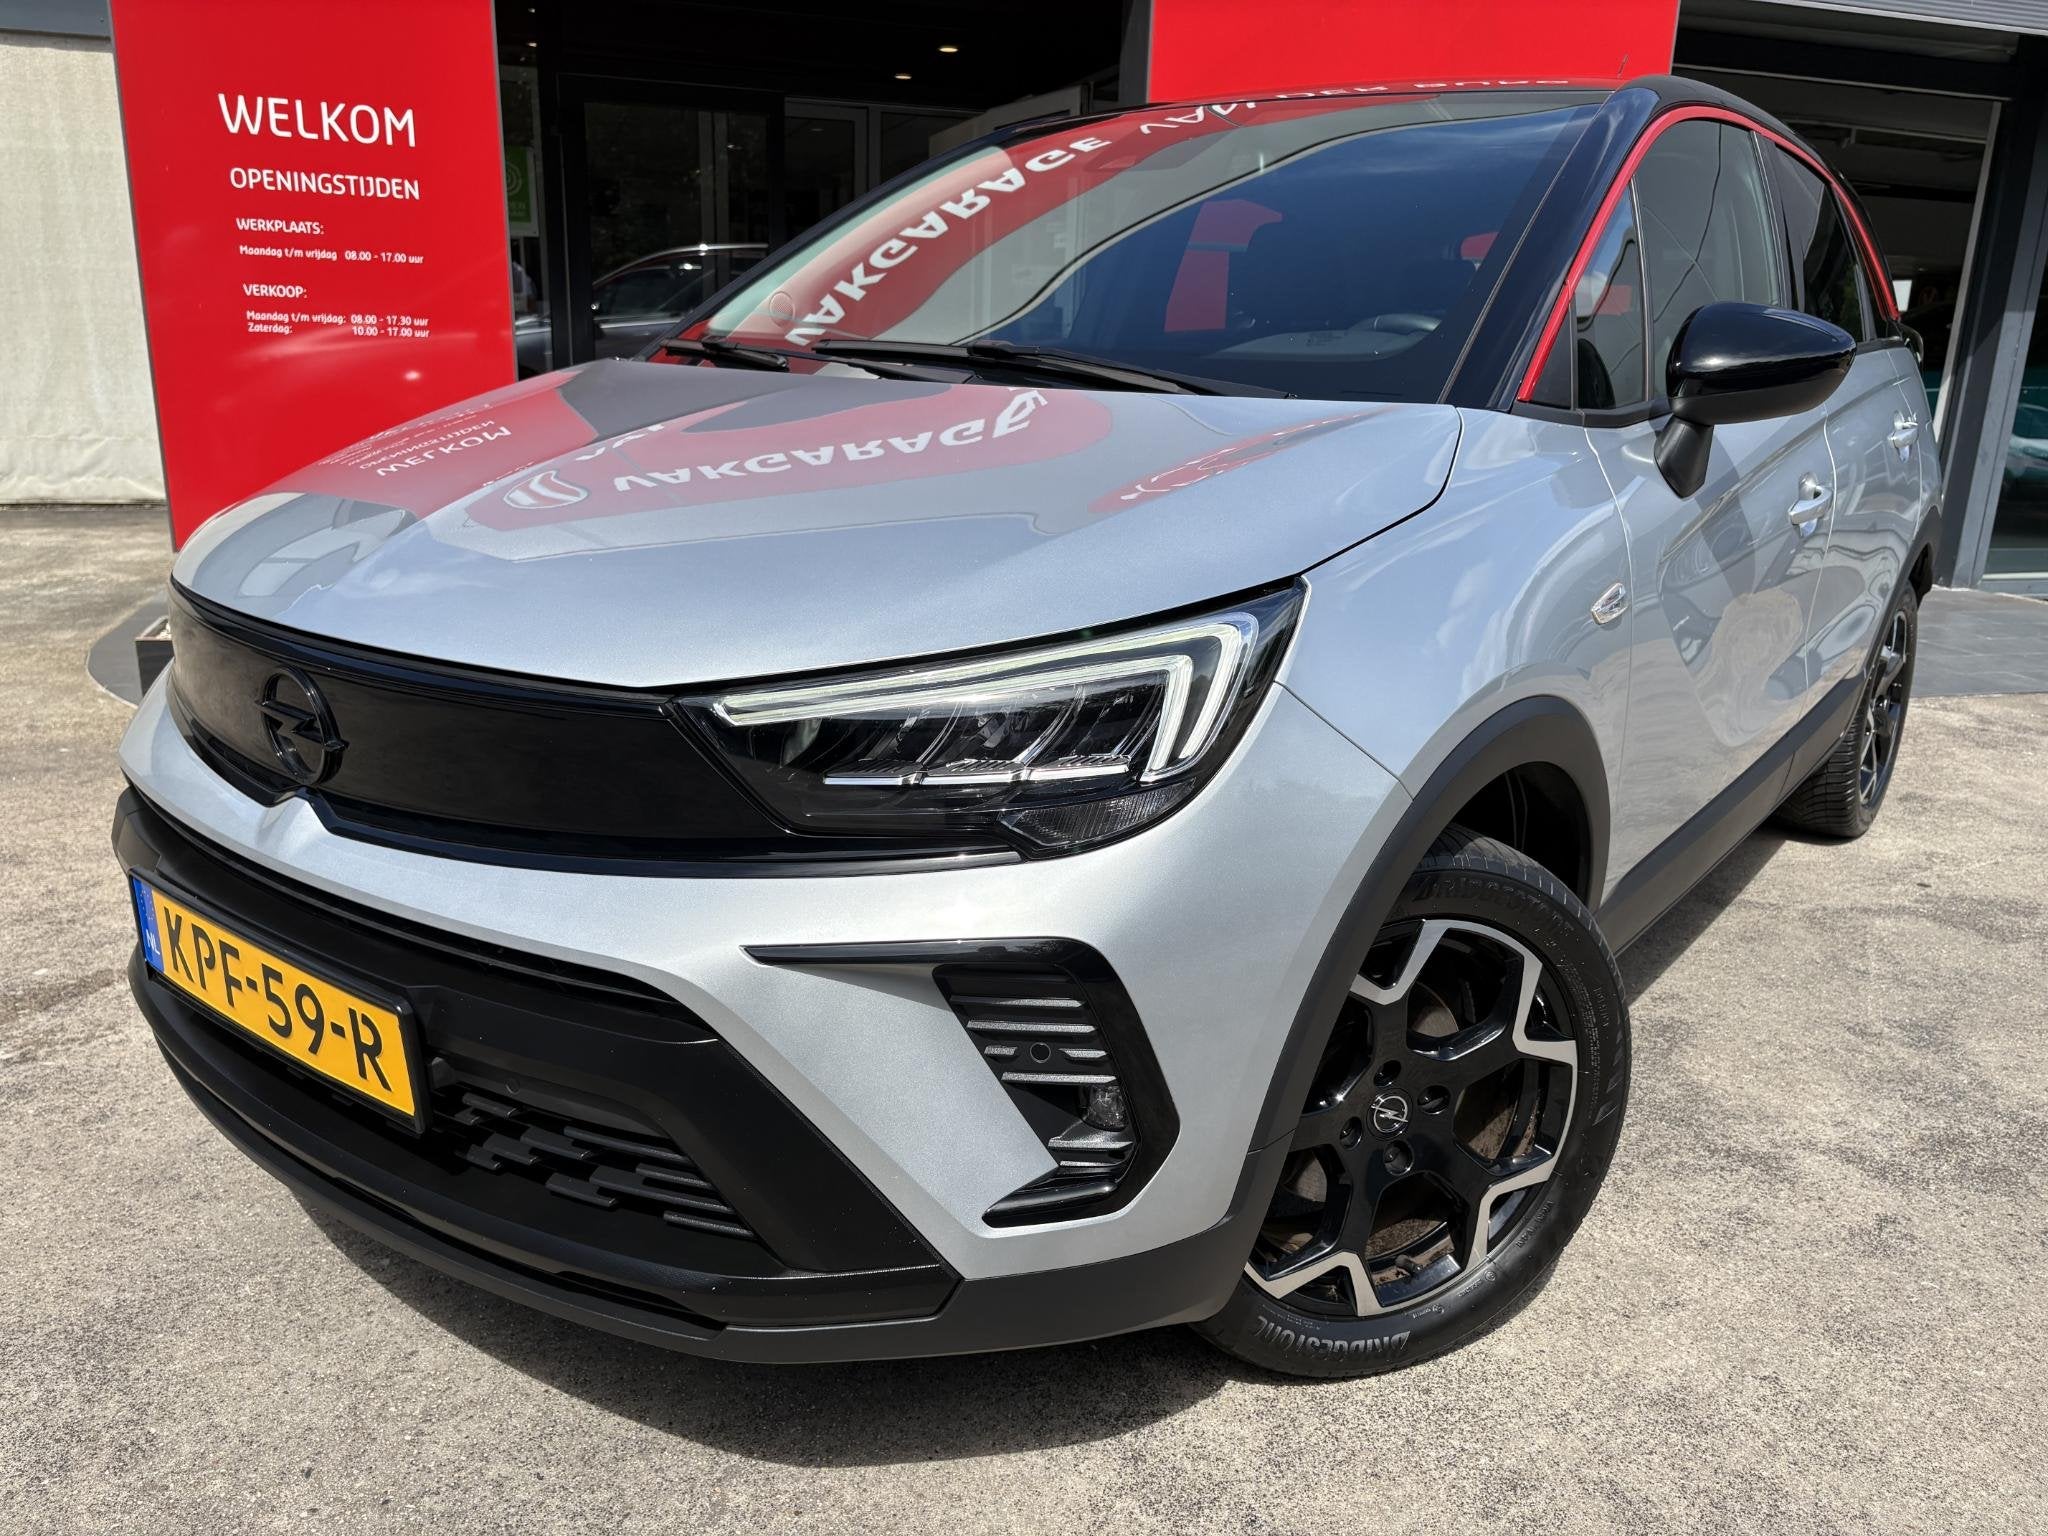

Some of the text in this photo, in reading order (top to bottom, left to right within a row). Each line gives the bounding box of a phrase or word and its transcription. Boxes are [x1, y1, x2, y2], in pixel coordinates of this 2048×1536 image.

[217, 93, 416, 147] WELKOM
[229, 167, 420, 200] OPENINGSTIJDEN
[235, 217, 324, 234] WERKPLAATS:
[239, 244, 283, 258] Maandag
[284, 247, 304, 258] t/m
[305, 248, 338, 261] vrijdag
[344, 250, 372, 262] 08.00
[380, 252, 407, 263] 17.00
[408, 255, 424, 264] uur
[242, 283, 307, 298] VERKOOP:
[246, 310, 290, 323] Maandag
[291, 312, 310, 322] t/m
[312, 313, 347, 325] vrijdag:
[350, 314, 378, 325] 08.00
[386, 315, 412, 326] 17.30
[413, 318, 429, 326] uur
[247, 322, 293, 335] Zaterdag:
[351, 325, 378, 336] 10.00
[387, 326, 413, 337] 17.00
[414, 328, 430, 337] uur
[145, 928, 161, 955] NL
[163, 906, 393, 1093] KPF-59-R
